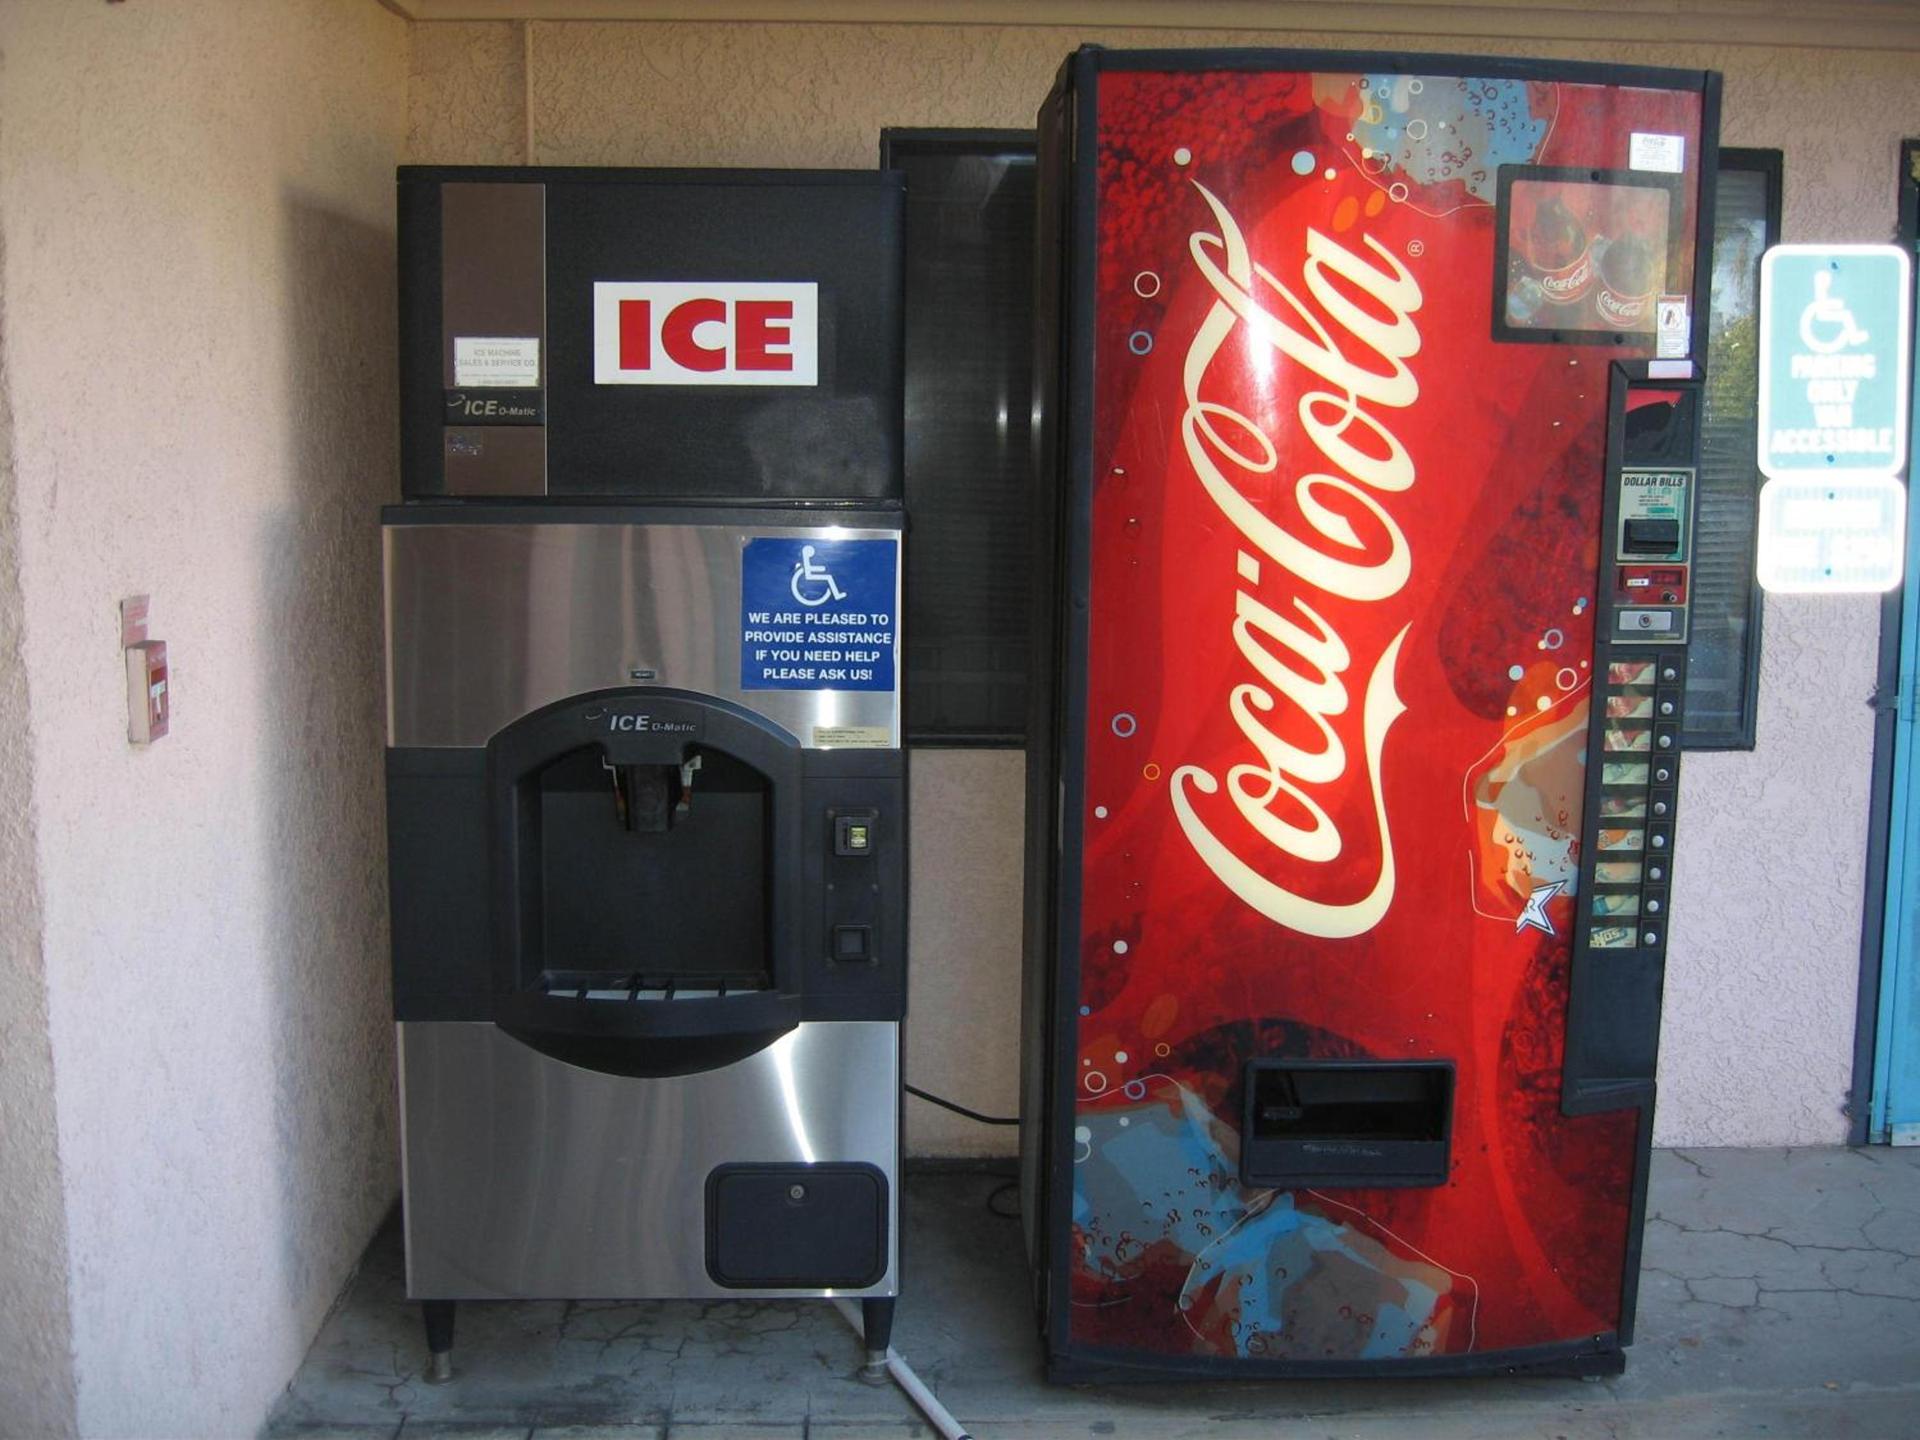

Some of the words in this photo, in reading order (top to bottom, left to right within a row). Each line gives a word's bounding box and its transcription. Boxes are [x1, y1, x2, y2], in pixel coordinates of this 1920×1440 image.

[618, 297, 794, 373] ICE
[464, 400, 498, 416] ICE
[498, 406, 537, 416] O-Matic
[1623, 476, 1657, 487] DOLLAR
[1658, 477, 1684, 488] BILLS
[1170, 177, 1423, 940] Coca-Cola
[749, 612, 770, 624] WE
[773, 612, 801, 624] ARE
[804, 613, 867, 625] PLEASED
[870, 613, 889, 626] TO
[744, 631, 804, 643] PROVIDE
[808, 632, 892, 644] ASSISTANCE
[755, 650, 768, 661] IF
[771, 650, 800, 661] YOU
[804, 650, 841, 662] NEED
[845, 651, 880, 662] HELP
[763, 668, 815, 679] PLEASE
[818, 668, 847, 680] ASK
[849, 669, 873, 680] US!
[610, 715, 650, 731] ICE
